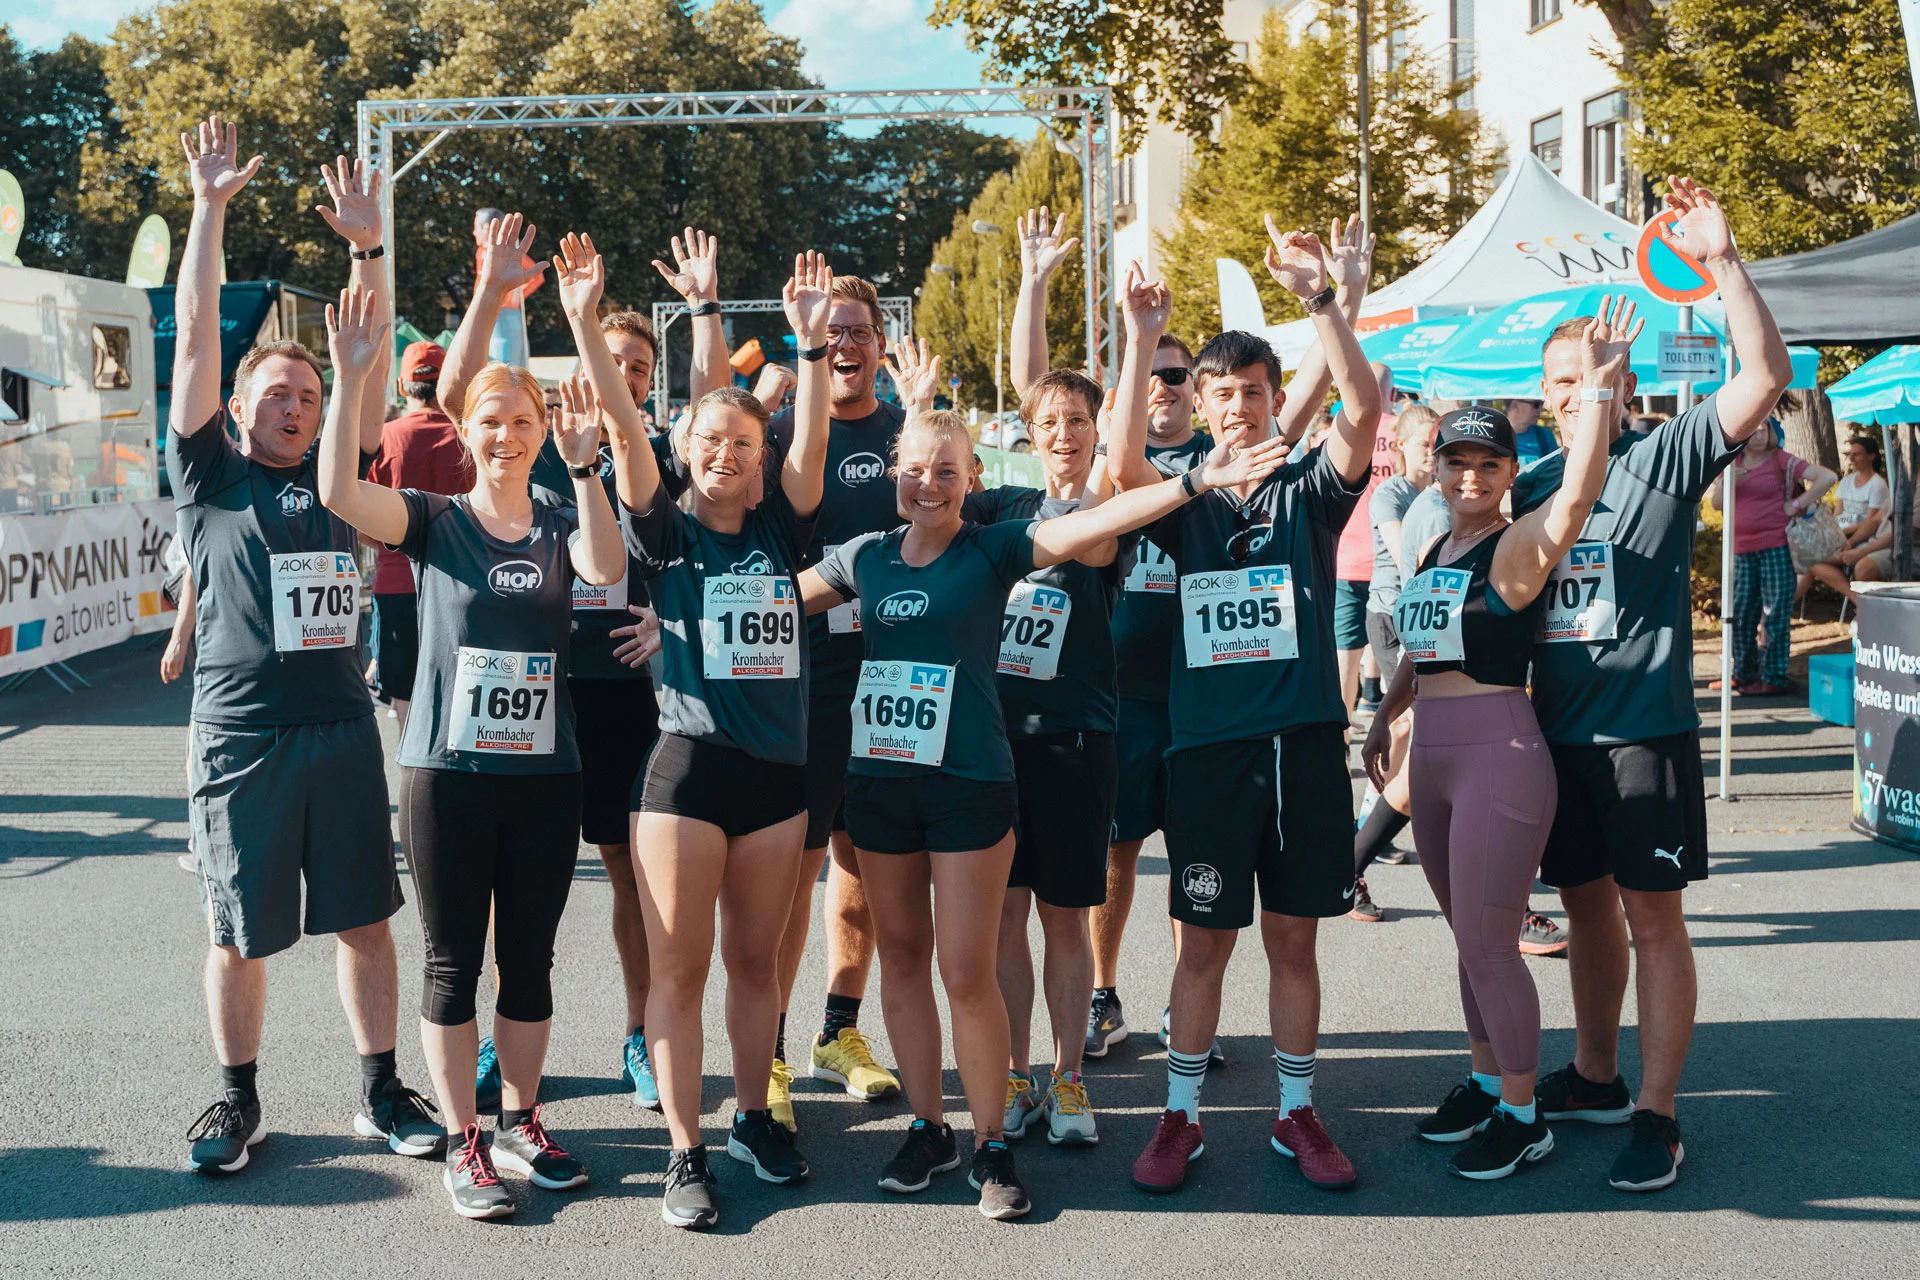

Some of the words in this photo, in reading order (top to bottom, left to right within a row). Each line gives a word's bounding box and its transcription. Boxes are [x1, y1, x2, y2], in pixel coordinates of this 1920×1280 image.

[1665, 352, 1715, 363] TOILETTEN
[845, 463, 880, 479] HOF
[278, 559, 313, 572] AOK
[496, 570, 538, 589] HOF
[1187, 577, 1221, 592] AOK
[572, 586, 607, 599] mbacher
[711, 581, 746, 595] AOK
[1546, 576, 1601, 610] 707
[286, 584, 353, 618] 1703
[883, 599, 925, 617] HOF
[1196, 597, 1282, 634] 1695
[1398, 601, 1450, 632] 1705
[302, 623, 347, 638] Krombacher
[718, 611, 794, 645] 1699
[1001, 614, 1055, 650] 702
[1211, 636, 1270, 653] Krombacher
[465, 655, 499, 670] AOK
[732, 651, 785, 666] Krombacher
[999, 650, 1034, 666] mbacher
[1216, 651, 1266, 660] ALKOHOLFREI
[861, 666, 887, 679] AOK
[467, 685, 549, 721] 1697
[861, 694, 937, 731] 1696
[477, 725, 535, 742] Krombacher
[870, 732, 918, 750] Krombacher
[480, 741, 530, 750] ALKOHOLFREI
[872, 748, 912, 757] ALKOHOLFREI
[1895, 813, 1914, 827] robin
[1186, 878, 1217, 896] JSG
